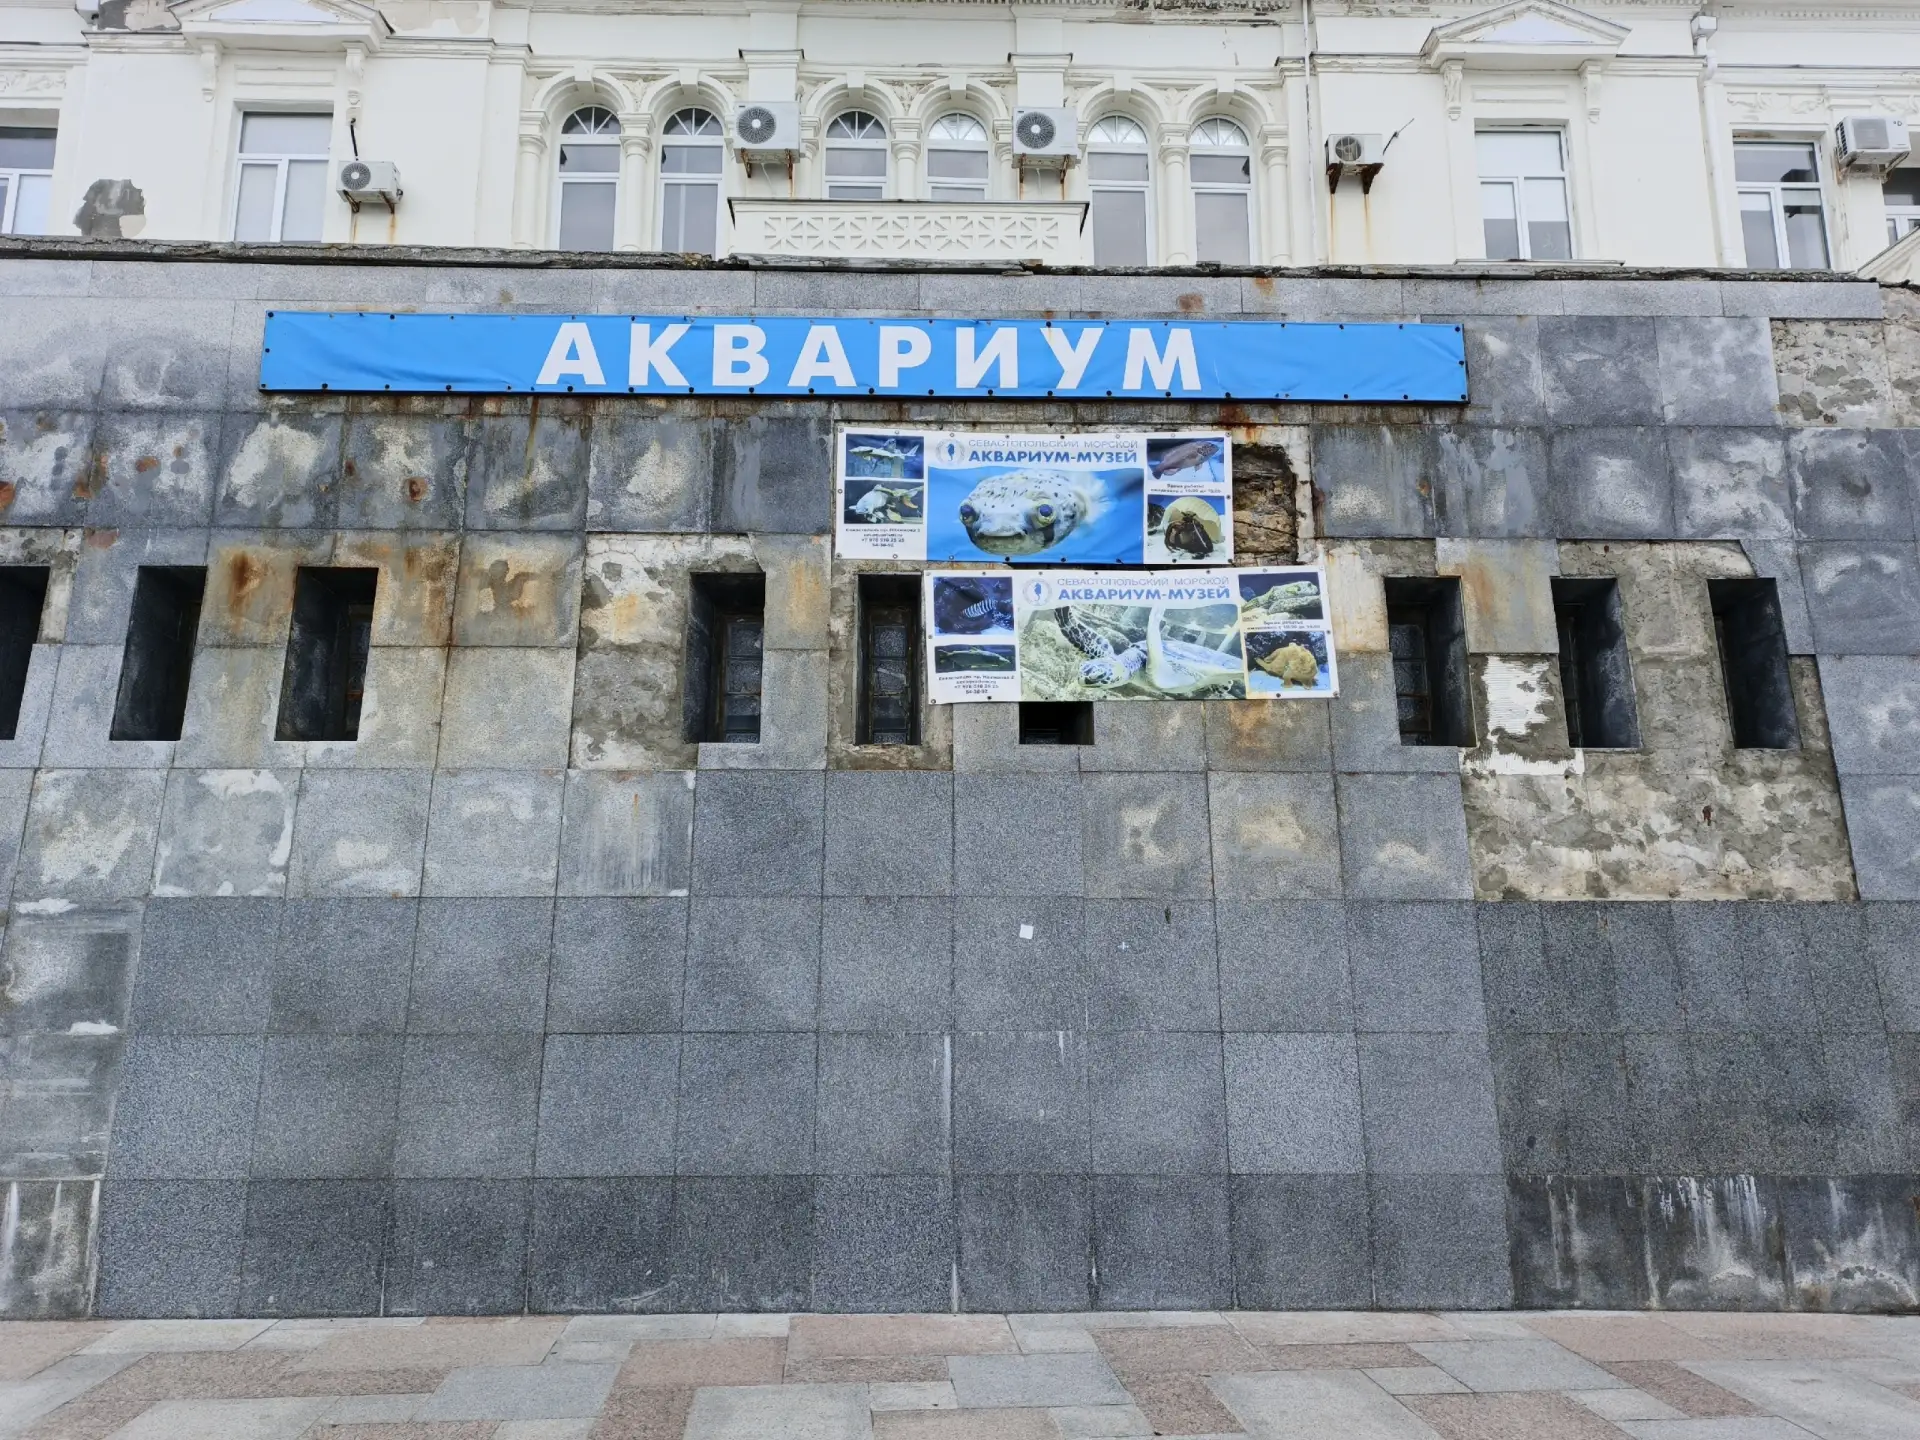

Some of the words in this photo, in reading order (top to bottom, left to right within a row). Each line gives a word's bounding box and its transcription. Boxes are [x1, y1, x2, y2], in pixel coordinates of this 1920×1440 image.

[535, 322, 1201, 391] АКВАРИУМ
[968, 438, 1079, 448] СЕВАСТОПОЛЬСКИЙ
[1084, 439, 1138, 449] МОРСКОЙ
[968, 449, 1137, 463] АКВАРИУМ-МУЗЕЙ
[1057, 577, 1169, 586] СЕВАСТОПОЛЬСКИЙ
[1174, 576, 1229, 586] МОРСКОЙ
[1058, 586, 1230, 600] АКВАРИУМ-МУЗЕЙ
